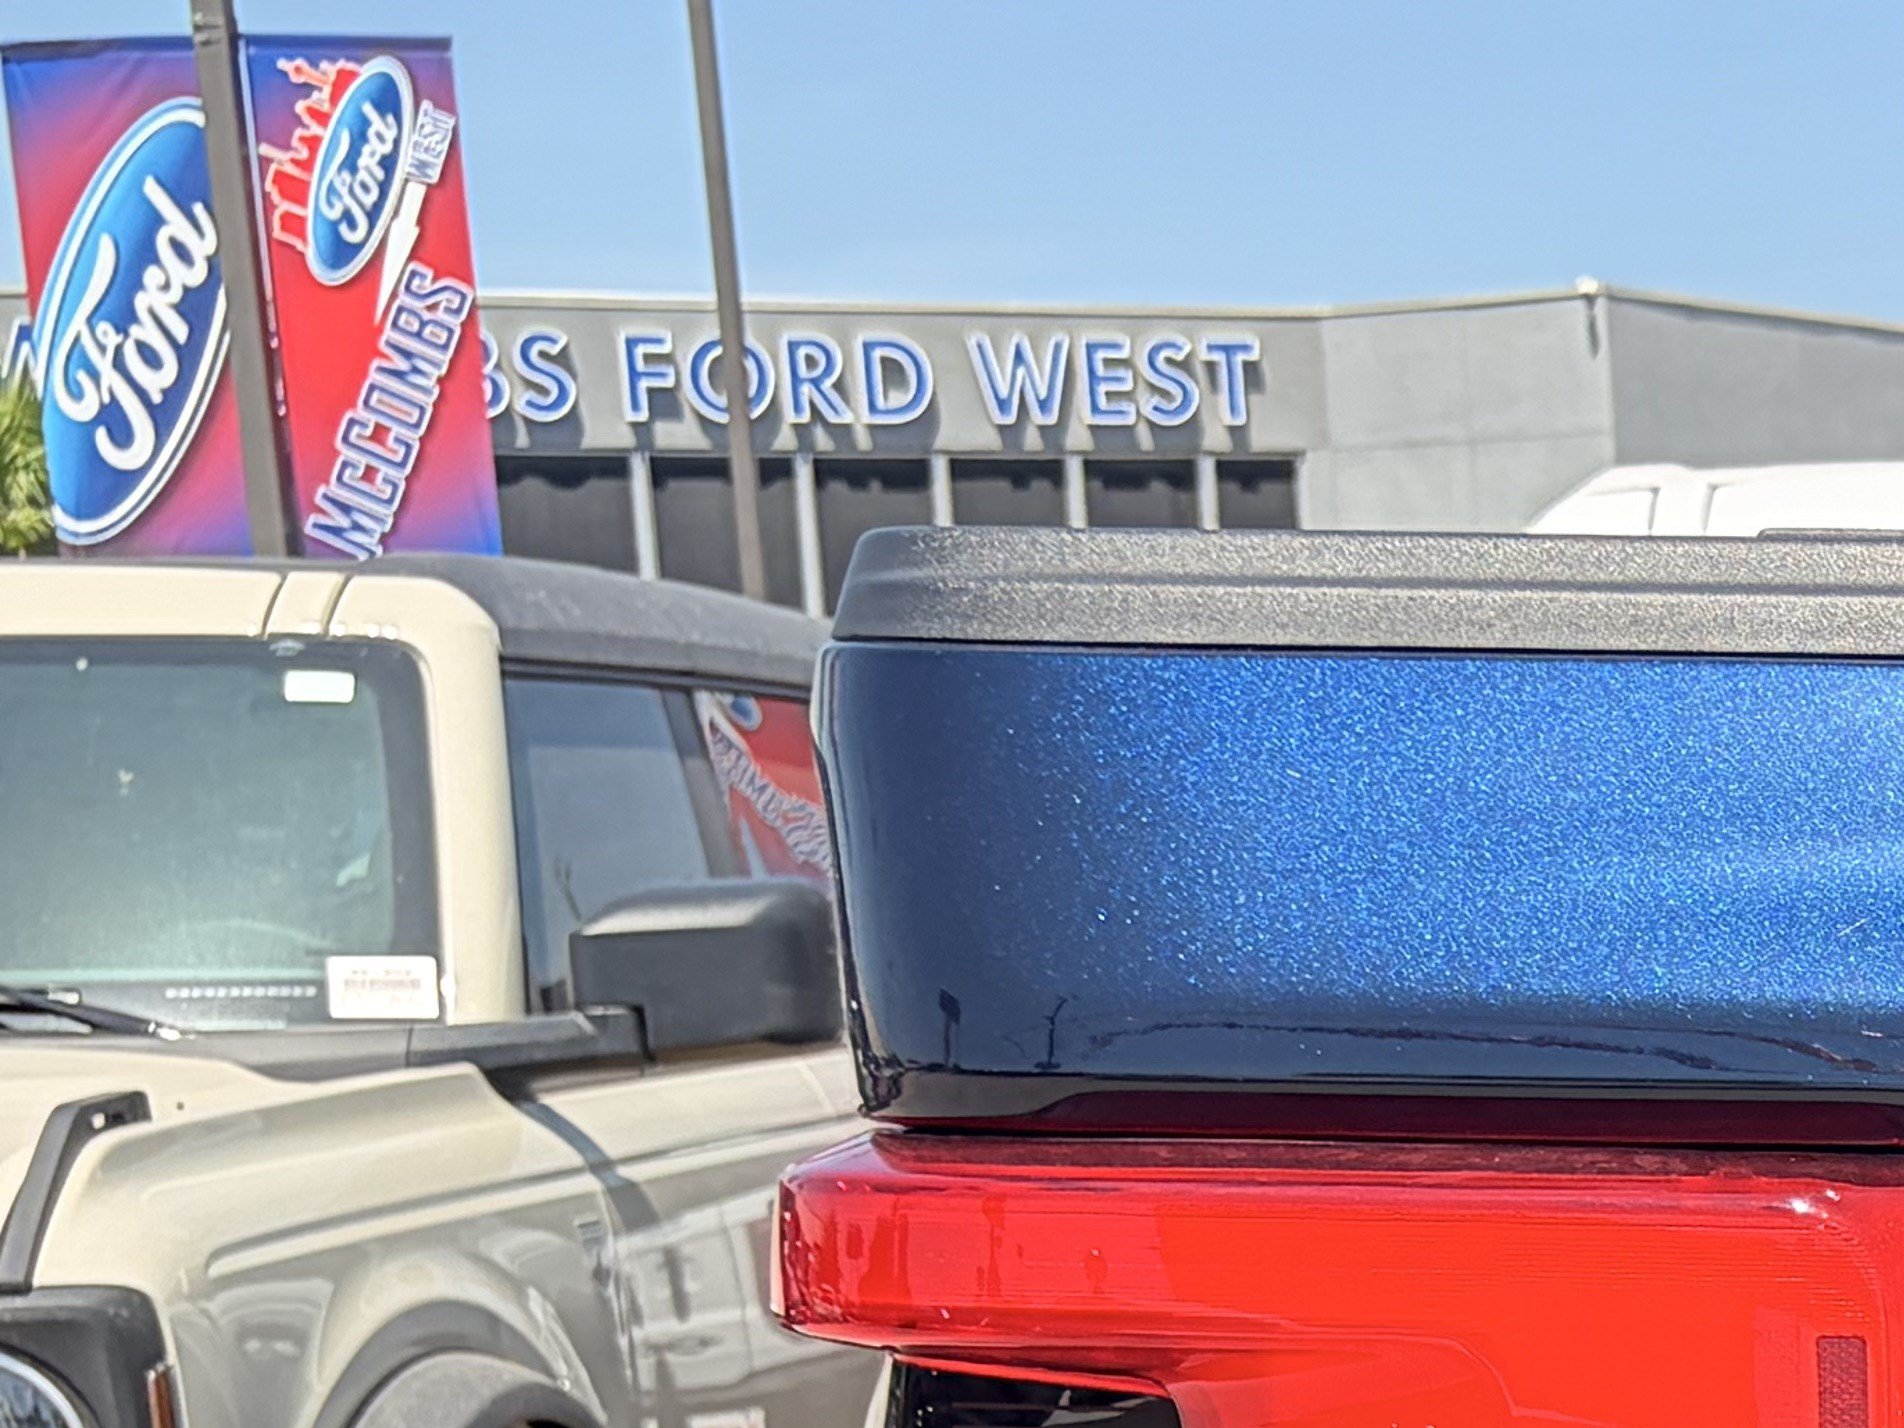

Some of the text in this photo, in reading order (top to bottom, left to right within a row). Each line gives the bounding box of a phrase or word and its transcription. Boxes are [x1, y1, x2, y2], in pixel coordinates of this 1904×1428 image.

[318, 102, 398, 244] Ford
[53, 175, 218, 471] Ford
[618, 329, 935, 425] FORD
[968, 331, 1263, 427] WEST
